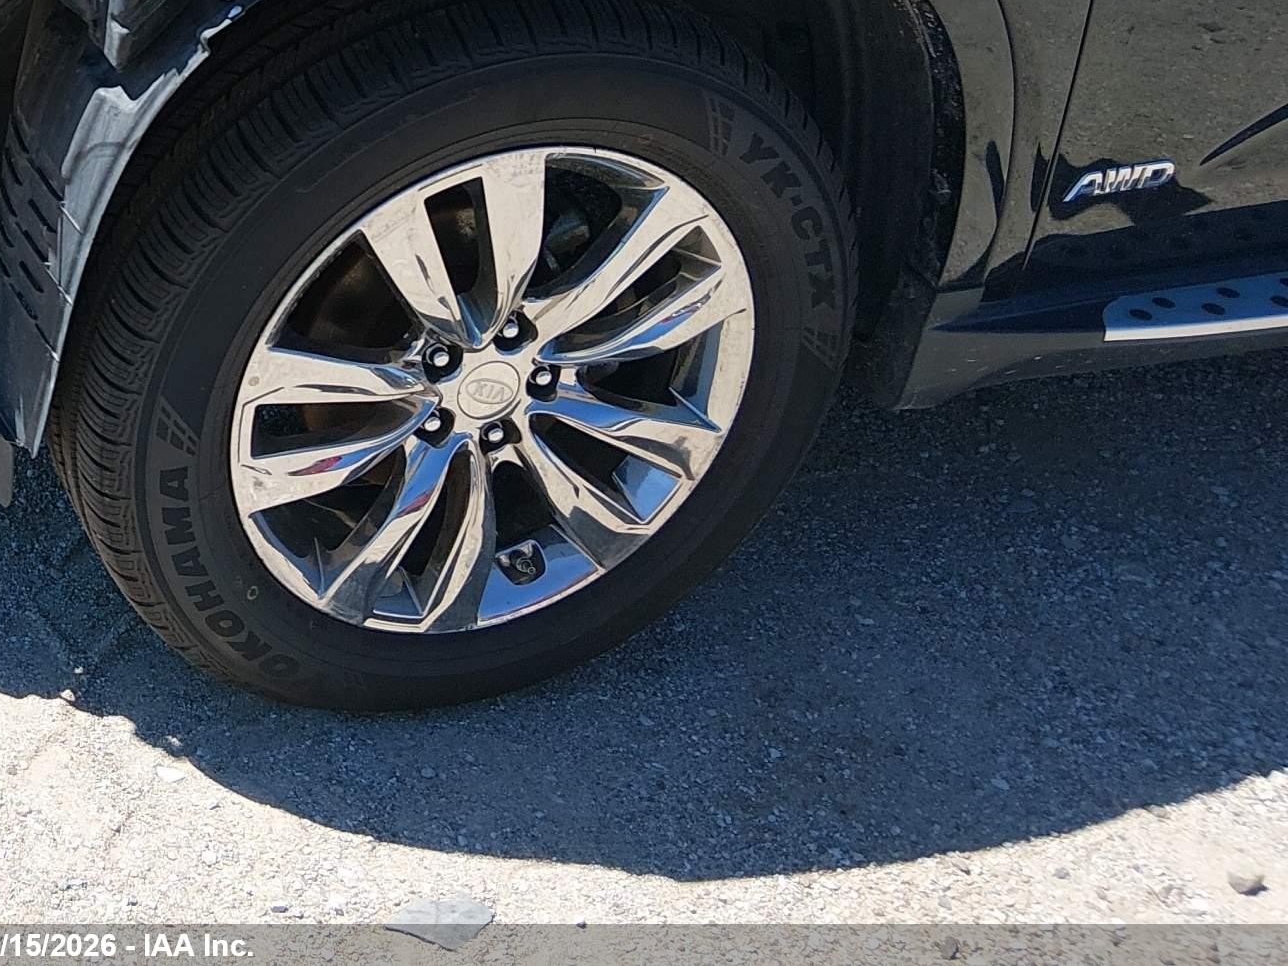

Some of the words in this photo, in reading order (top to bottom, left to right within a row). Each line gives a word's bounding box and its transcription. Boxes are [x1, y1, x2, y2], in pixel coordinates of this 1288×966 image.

[1062, 160, 1177, 203] AWD
[472, 381, 506, 402] KIA
[159, 466, 302, 677] OKOHAMA
